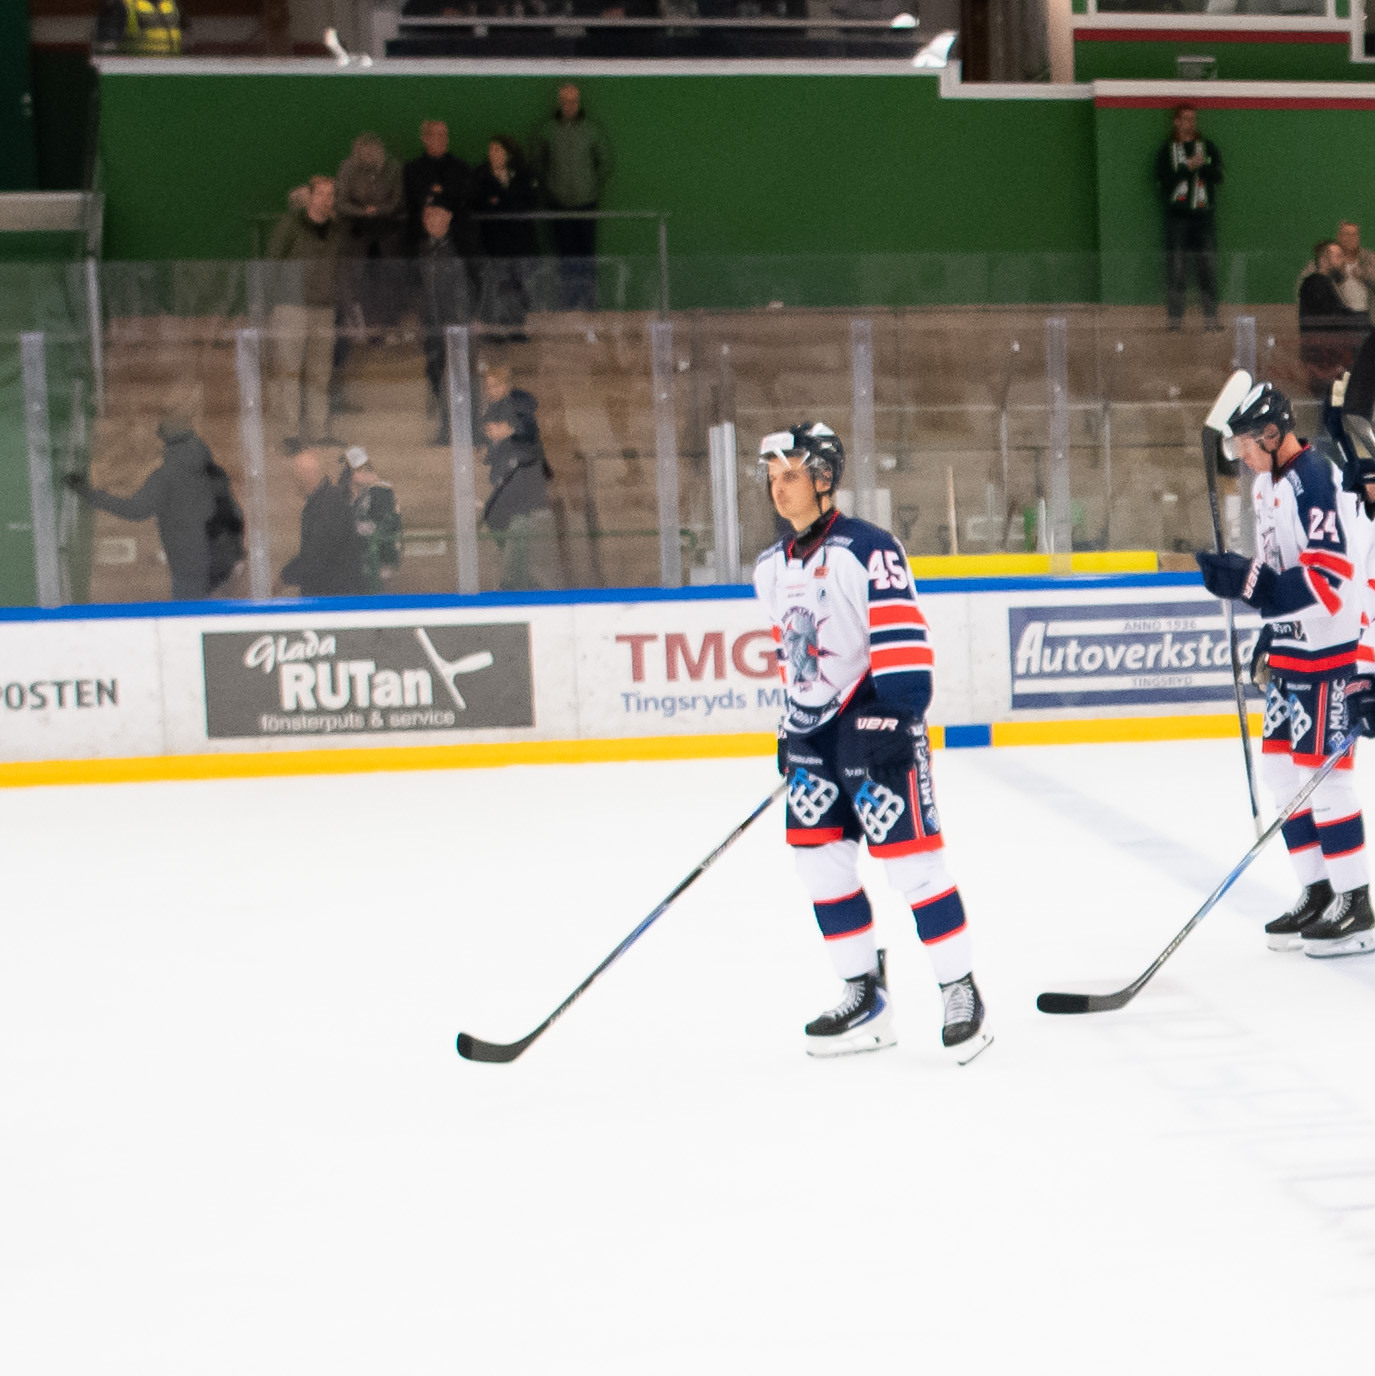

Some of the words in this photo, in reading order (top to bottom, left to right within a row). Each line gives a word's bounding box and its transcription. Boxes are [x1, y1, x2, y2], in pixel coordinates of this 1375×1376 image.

[1309, 507, 1341, 543] 24
[867, 550, 909, 591] 45
[243, 629, 337, 673] Glada
[614, 629, 779, 683] TMG
[0, 677, 118, 711] OSTEN
[620, 688, 748, 718] Tingsryds
[389, 710, 456, 729] service
